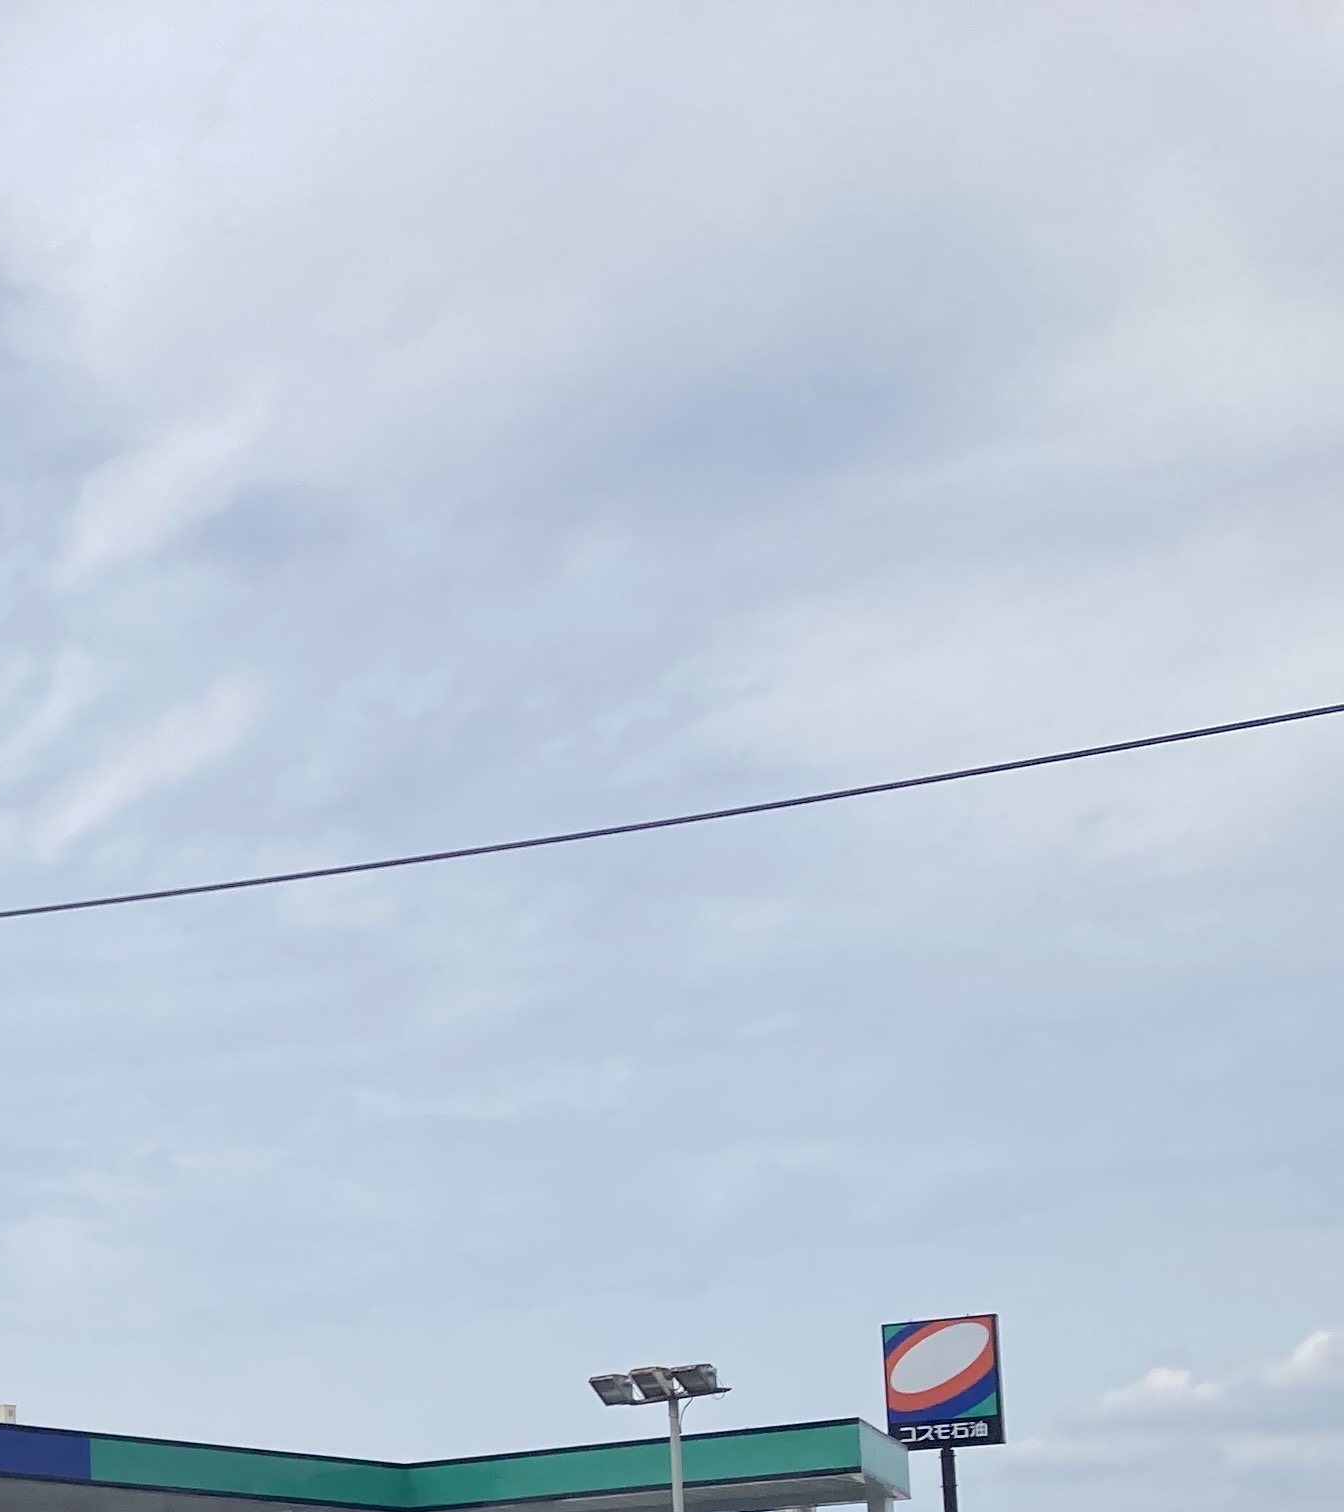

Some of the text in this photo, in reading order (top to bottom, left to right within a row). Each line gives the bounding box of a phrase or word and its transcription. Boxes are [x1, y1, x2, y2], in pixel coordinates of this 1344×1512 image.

[900, 1420, 989, 1443] コスモ石油
